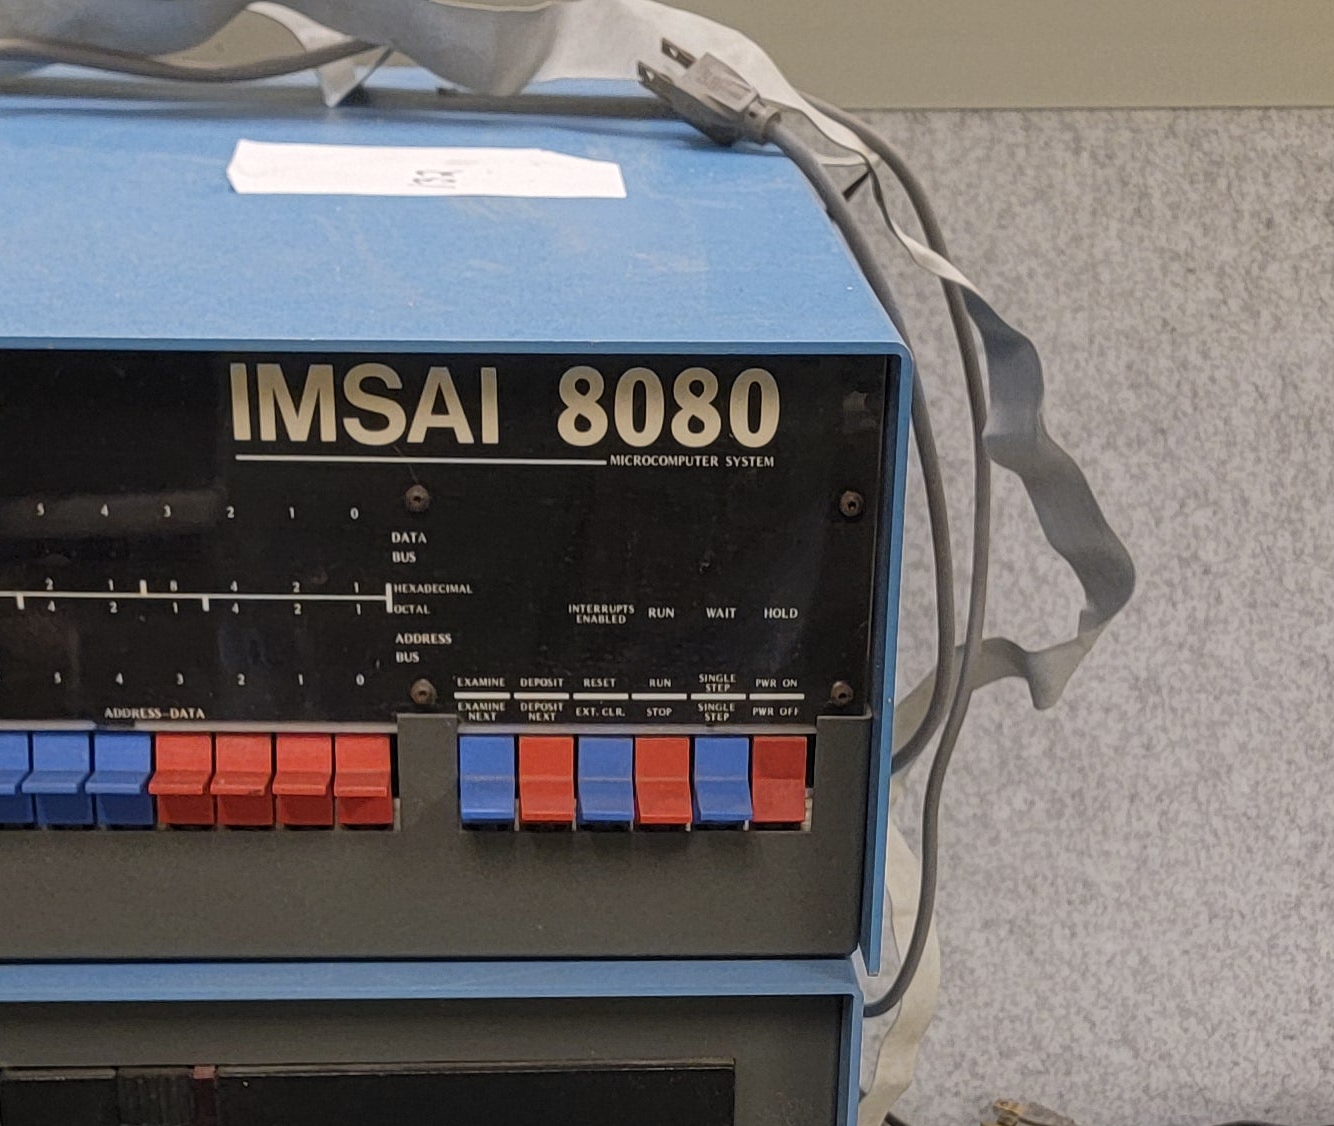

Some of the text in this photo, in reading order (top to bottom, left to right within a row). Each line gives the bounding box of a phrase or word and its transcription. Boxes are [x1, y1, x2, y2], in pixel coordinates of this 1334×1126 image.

[229, 362, 781, 449] IMSAI 8080
[609, 454, 775, 469] MICROCOMPUTER SYSTEM
[36, 502, 45, 516] 5
[100, 504, 109, 517] 4
[163, 504, 172, 518] 3
[226, 505, 235, 519] 2
[288, 506, 295, 519] 1
[350, 507, 359, 520] 0
[391, 531, 427, 544] DATA
[392, 551, 417, 563] BUS
[45, 577, 54, 591] 2
[108, 578, 114, 591] 1
[170, 580, 178, 592] 8
[230, 580, 238, 592] 4
[292, 581, 301, 593] 2
[354, 581, 359, 593] 1
[394, 582, 473, 595] HEXADECIMAL
[47, 600, 56, 612] 4
[110, 601, 118, 613] 2
[172, 601, 178, 613] 1
[231, 602, 240, 614] 4
[294, 603, 302, 615] 2
[356, 603, 361, 615] 1
[394, 603, 430, 615] OCTAL
[568, 603, 635, 615] INTERRUPTS
[648, 606, 798, 619] RUN WAIT HOLD
[576, 613, 627, 625] ENABLED
[395, 632, 452, 645] ADDRESS
[396, 651, 420, 663] BUS
[54, 672, 62, 684] 5
[115, 673, 124, 685] 4
[177, 673, 185, 686] 3
[237, 673, 246, 686] 2
[298, 674, 303, 686] 1
[356, 674, 365, 687] 0
[457, 678, 506, 688] EXAMINE
[520, 678, 564, 688] DEPOSIT
[583, 678, 616, 688] RESET
[649, 678, 672, 688] RUN
[698, 673, 736, 684] SINGLE
[755, 678, 798, 688] PWR ON
[705, 683, 731, 693] STEP
[457, 702, 506, 712] EXAMINE
[520, 702, 564, 712] DEPOSIT
[576, 707, 626, 717] EXT. CLR.
[646, 707, 673, 717] STOP
[697, 702, 735, 713] SINGLE
[752, 707, 774, 717] PWR
[468, 711, 497, 722] NEXT
[528, 711, 556, 722] NEXT
[704, 712, 730, 722] STEP
